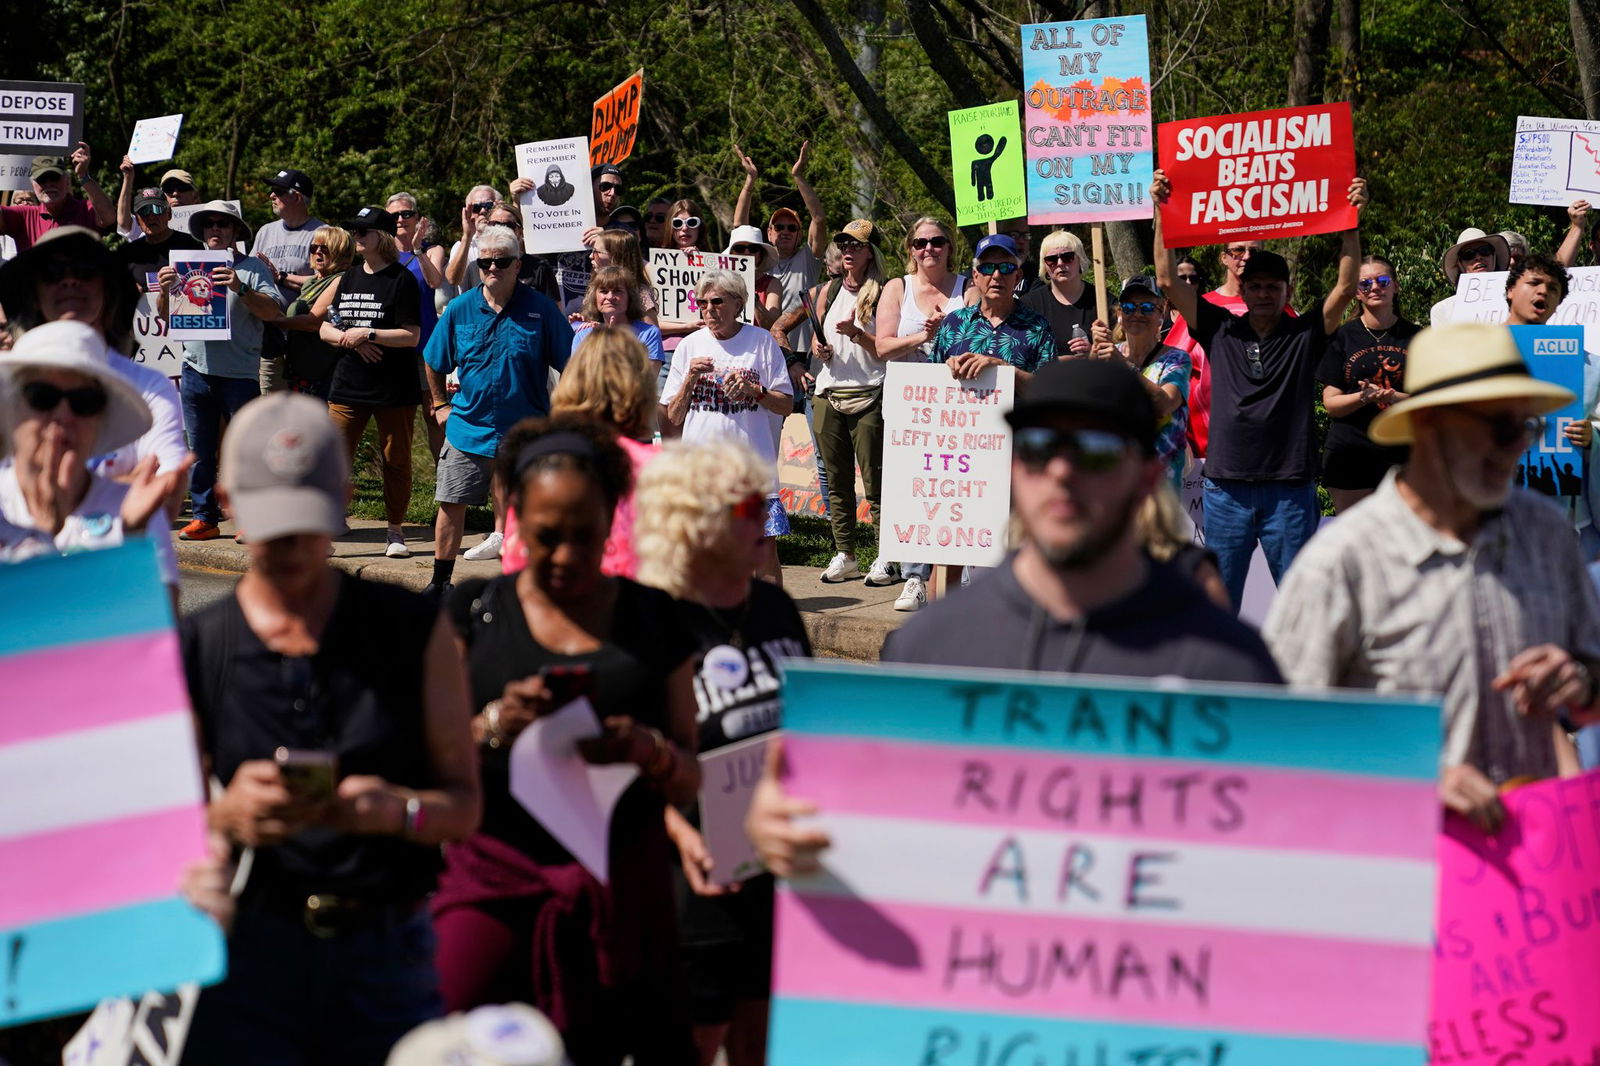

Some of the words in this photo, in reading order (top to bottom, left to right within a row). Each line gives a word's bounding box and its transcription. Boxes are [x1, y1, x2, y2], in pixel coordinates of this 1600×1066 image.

[1030, 26, 1082, 50] ALL
[1091, 23, 1125, 47] OF
[1058, 51, 1102, 76] MY
[1, 95, 67, 111] DEPOSE
[1026, 86, 1147, 112] OUTRAGE
[594, 83, 638, 142] DUMP
[3, 126, 64, 141] TRUMP
[1028, 121, 1101, 148] CAN'T
[1106, 125, 1147, 147] FIT
[1176, 112, 1332, 161] SOCIALISM
[526, 143, 576, 154] REMEMBER
[527, 155, 577, 165] REMEMBER
[1036, 157, 1073, 179] ON
[1090, 152, 1134, 176] MY
[1217, 151, 1296, 187] BEATS
[1054, 182, 1143, 206] SIGN!!
[1189, 178, 1330, 225] FASCISM!
[533, 221, 583, 230] NOVEMBER
[654, 252, 679, 266] MY
[687, 254, 749, 272] RIGHTS
[656, 267, 705, 287] SHOU
[1463, 277, 1497, 304] BE
[172, 315, 226, 329] RESIST
[1536, 341, 1576, 353] ACLU
[903, 385, 938, 404] OUR
[945, 386, 1002, 405] FIGHT
[911, 406, 933, 424] IS
[940, 409, 980, 428] NOT
[891, 429, 931, 447] LEFT
[936, 434, 957, 450] VS
[963, 432, 1006, 450] RIGHT
[923, 452, 971, 473] ITS
[912, 477, 987, 498] RIGHT
[893, 523, 992, 548] WRONG
[949, 683, 1231, 755] TRANS
[954, 759, 1247, 832] RIGHTS
[978, 838, 1182, 909] ARE
[943, 927, 1213, 1006] HUMAN
